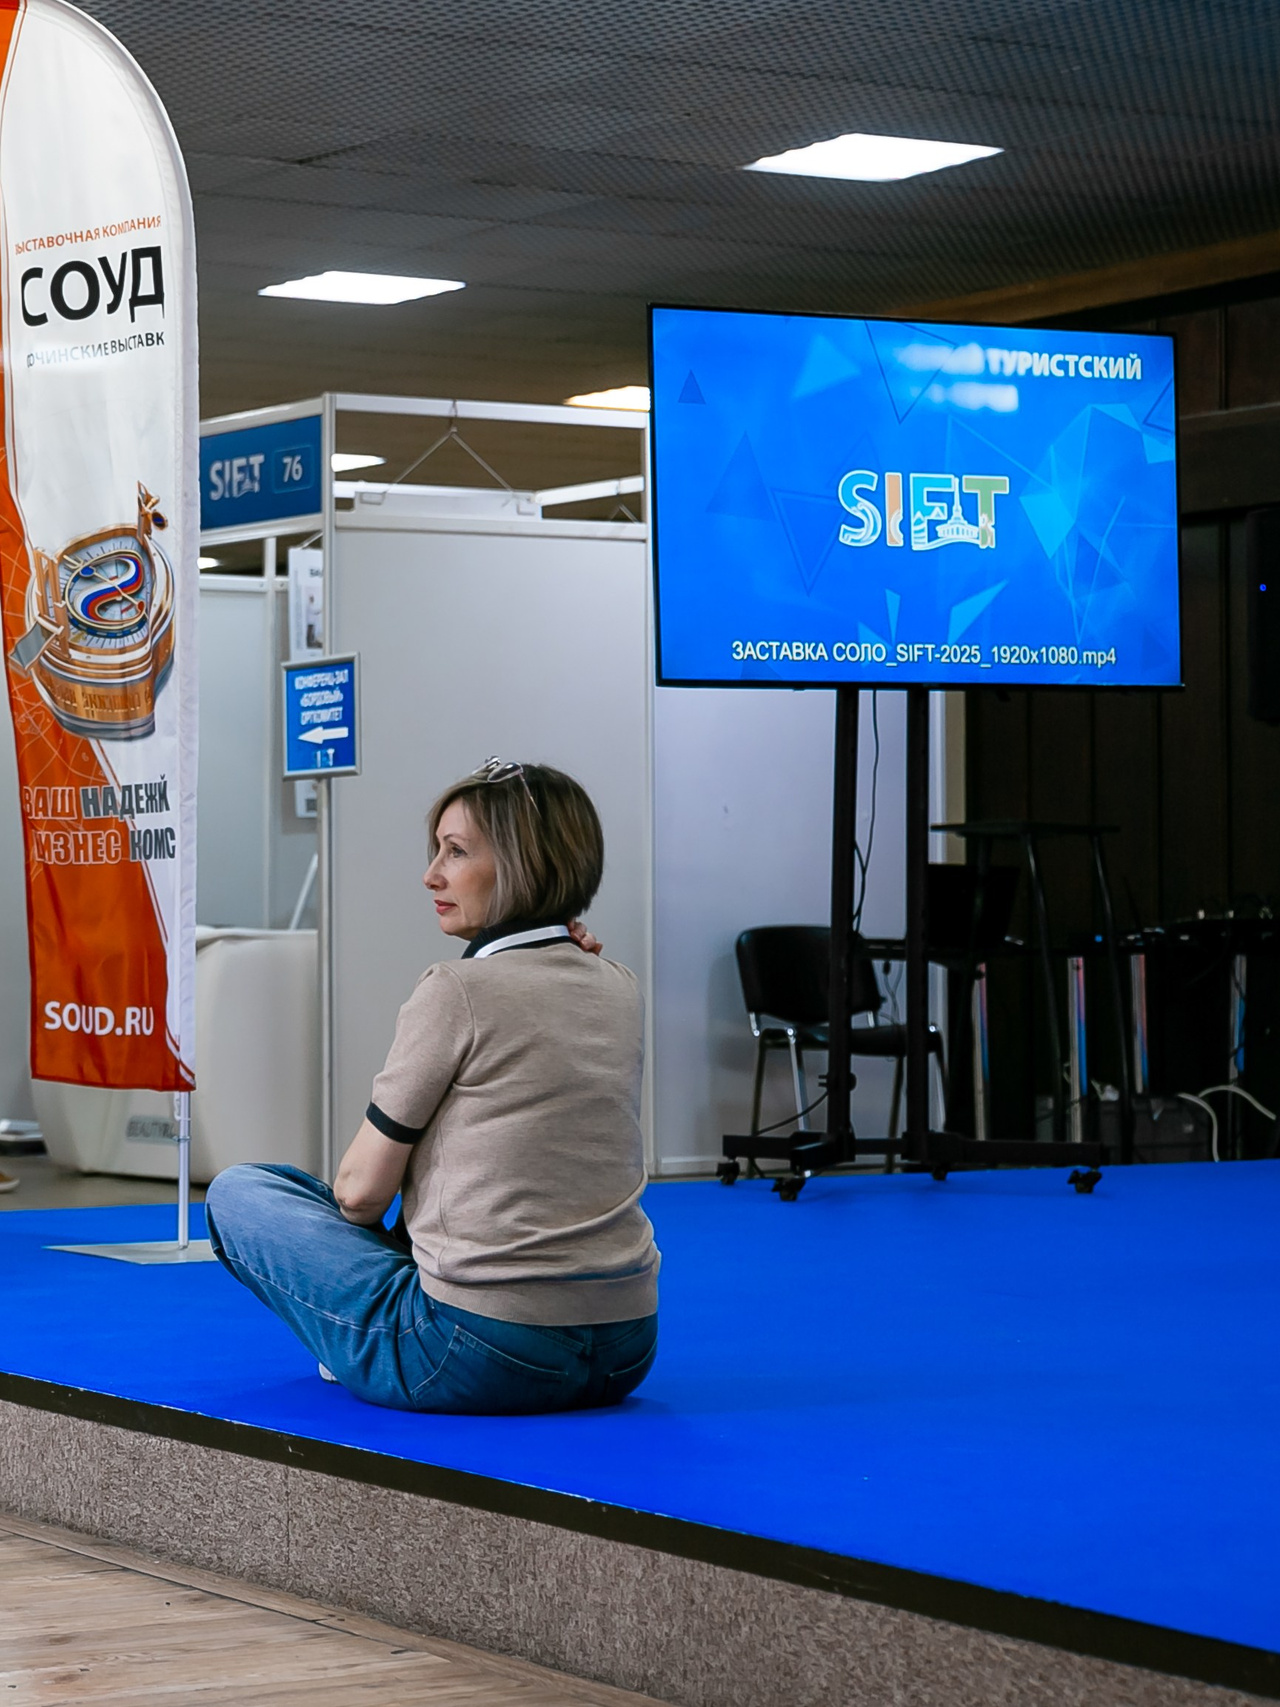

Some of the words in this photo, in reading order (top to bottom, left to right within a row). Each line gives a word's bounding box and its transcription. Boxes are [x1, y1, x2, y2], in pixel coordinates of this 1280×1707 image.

[102, 215, 161, 238] КОМПАНИЯ
[21, 245, 165, 327] СОУД
[986, 347, 1142, 380] ТУРИСТСКИЙ
[209, 453, 265, 501] SIFT
[282, 455, 303, 483] 76
[838, 469, 1010, 551] SIFT
[731, 640, 829, 661] ЗАСТАВКА
[23, 786, 78, 820] ВАШ
[32, 829, 121, 865] ИЗНЕС
[44, 1001, 154, 1036] SOUD.RU
